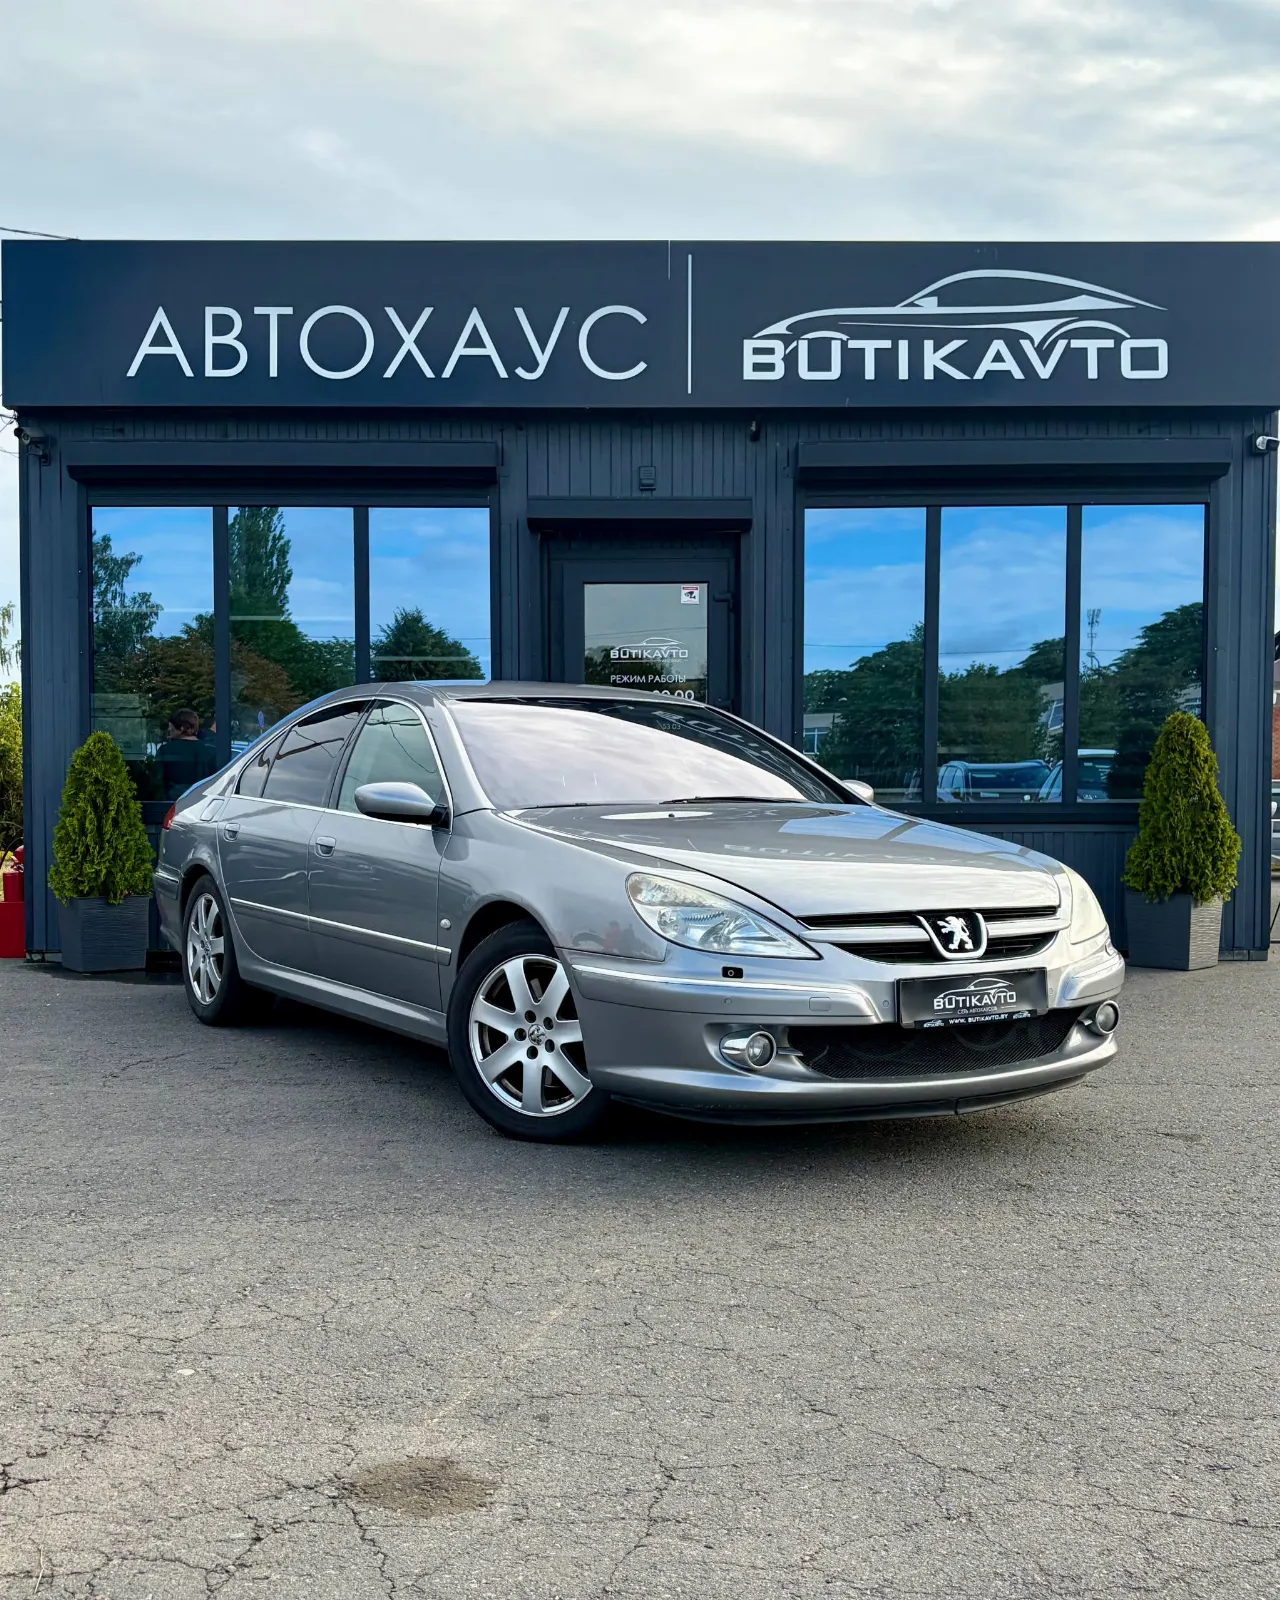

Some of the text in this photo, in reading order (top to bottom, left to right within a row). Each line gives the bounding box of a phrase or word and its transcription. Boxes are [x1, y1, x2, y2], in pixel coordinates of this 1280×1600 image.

[126, 304, 648, 380] АВТОХАУС
[743, 336, 1169, 380] BUTIKAVTO
[610, 648, 688, 659] BUTIKAVTO
[610, 674, 686, 684] РЕЖИМ РАБОТЫ
[933, 992, 1016, 1009] BUTIKAVTO
